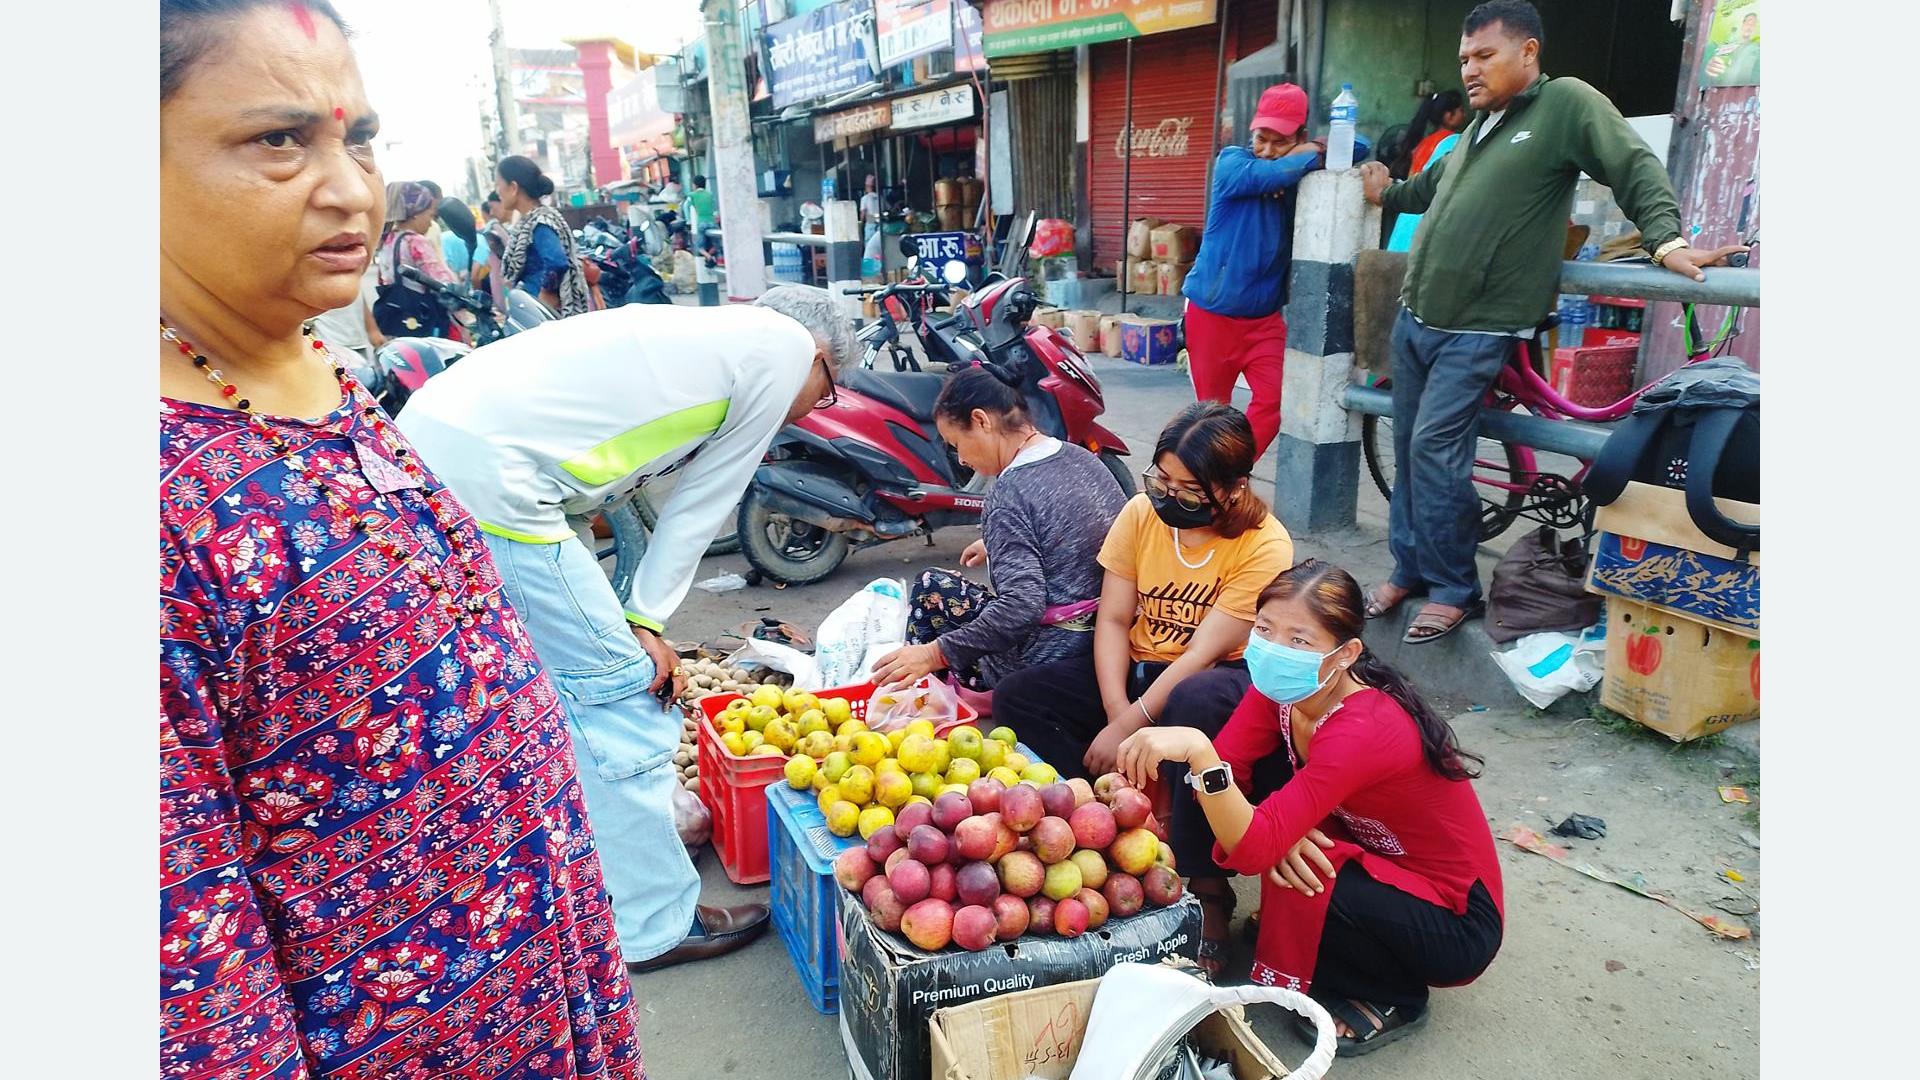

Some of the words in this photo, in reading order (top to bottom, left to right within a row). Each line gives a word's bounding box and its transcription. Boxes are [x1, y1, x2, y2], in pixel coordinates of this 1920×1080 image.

[1114, 946, 1150, 965] Fresh
[1156, 933, 1188, 956] Apple
[912, 983, 980, 1005] Premium
[983, 973, 1035, 993] Quality
